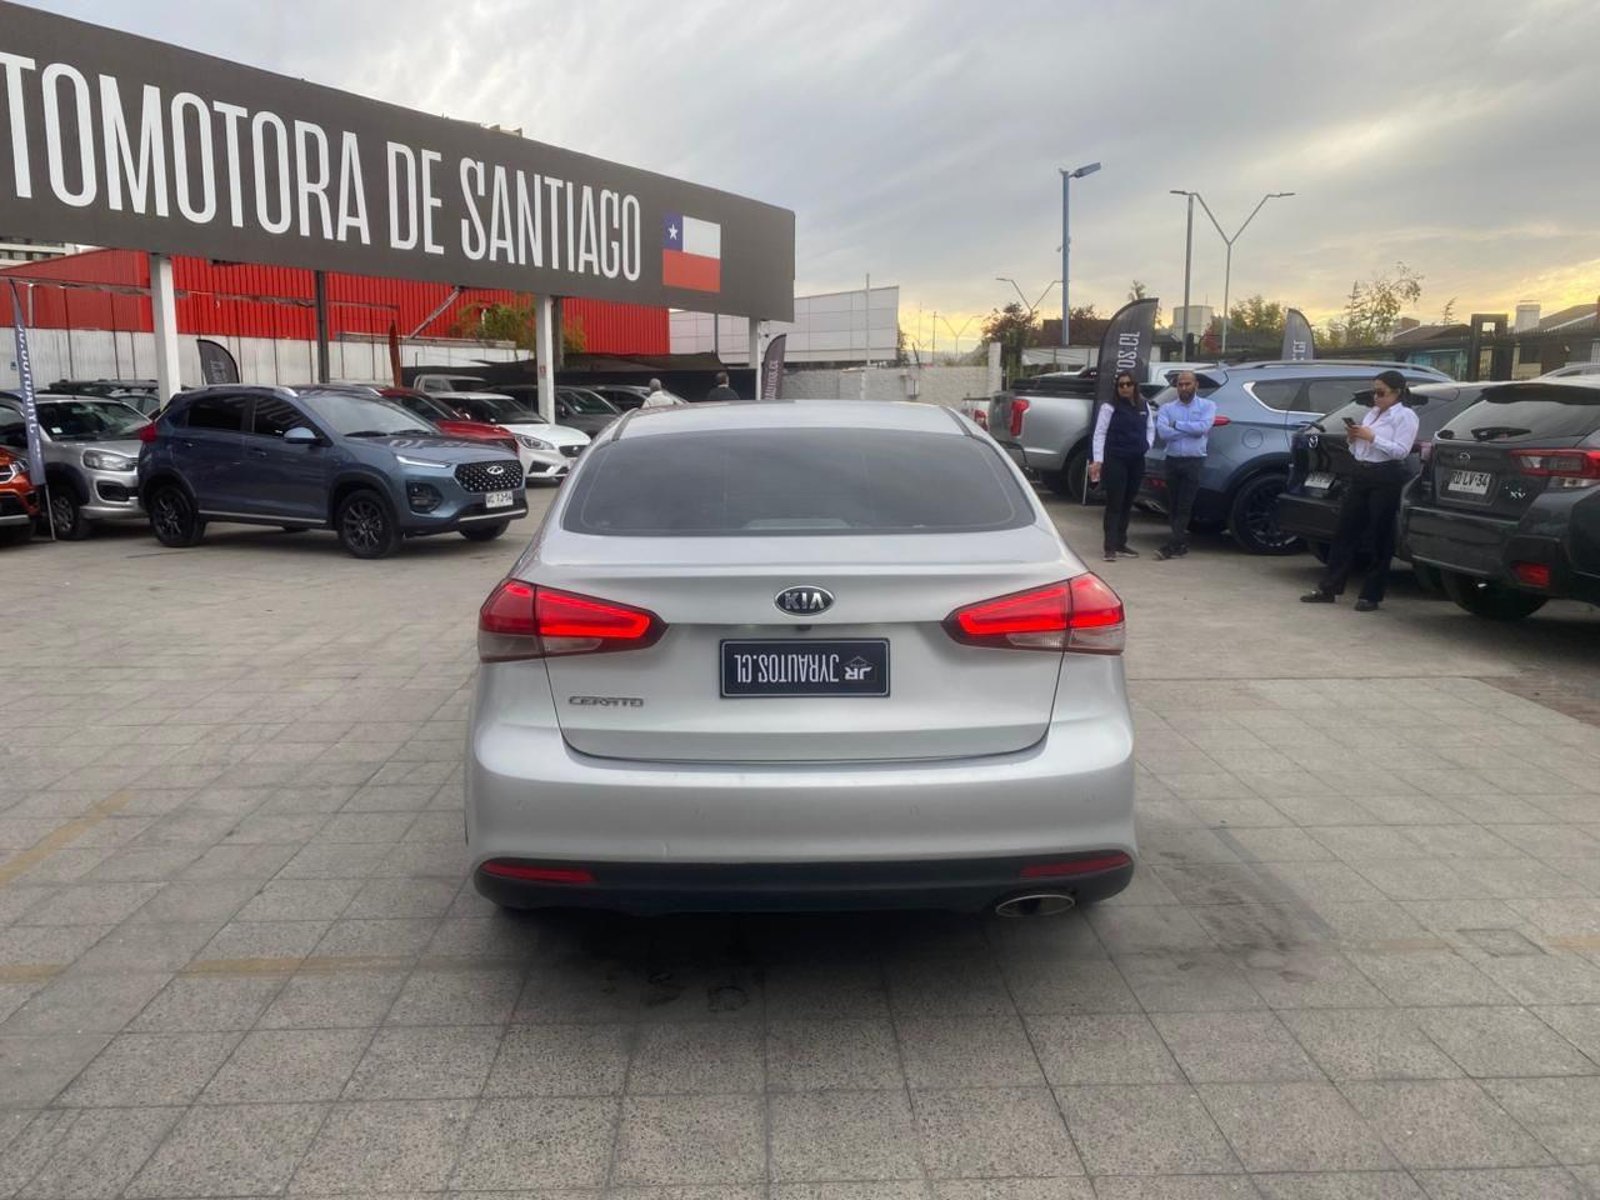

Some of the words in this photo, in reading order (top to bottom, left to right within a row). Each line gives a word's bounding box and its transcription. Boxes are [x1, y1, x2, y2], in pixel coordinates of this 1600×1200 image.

[0, 52, 371, 246] TOMOTORA
[386, 141, 445, 256] DE
[460, 157, 641, 282] SANTIAGO
[785, 592, 824, 609] KIA
[733, 653, 840, 683] JYRAUTOS.CL
[845, 666, 872, 680] JR
[569, 695, 644, 707] CERATO
